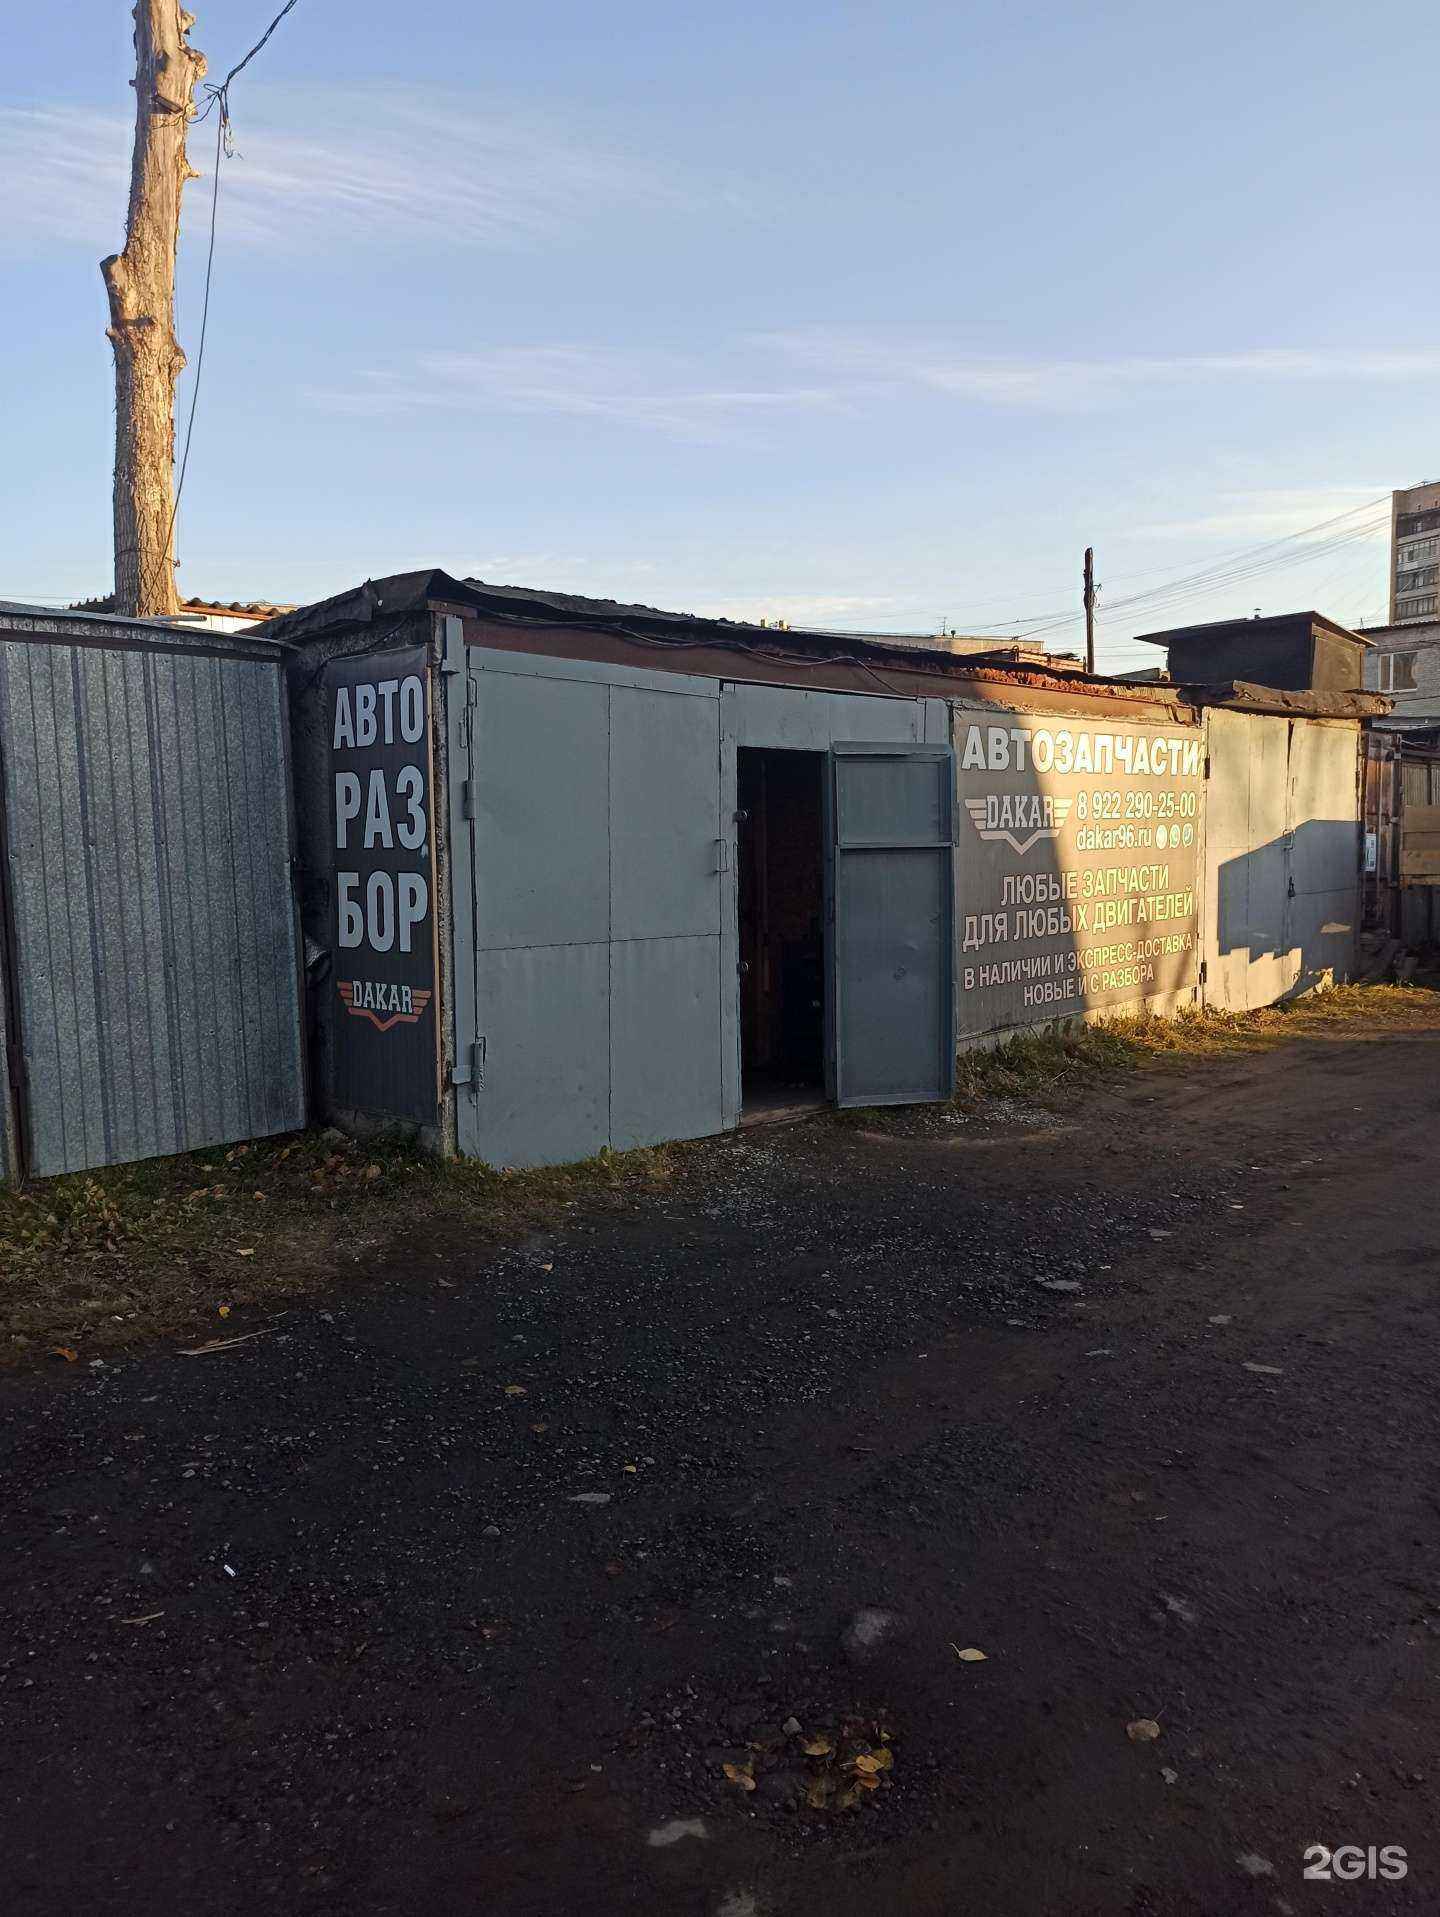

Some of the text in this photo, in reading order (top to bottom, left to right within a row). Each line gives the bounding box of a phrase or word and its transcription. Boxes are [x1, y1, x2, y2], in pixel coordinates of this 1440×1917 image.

[333, 675, 424, 749] АВТО
[961, 725, 1199, 776] АВТОЗАПЧАСТИ
[335, 765, 427, 849] РАЗ
[986, 794, 1056, 829] DAKAR
[1077, 790, 1197, 820] 8 922 290-25-00
[1076, 823, 1152, 851] dakar96.ru
[1000, 864, 1169, 906] ЛЮБЫЕ ЗАПЧАСТИ
[337, 870, 428, 953] БОР
[962, 885, 1194, 953] ДЛЯ ЛЮБЫХ ДВИГАТЕЛЕЙ
[963, 933, 1193, 990] В НАЛИЧИИ И ЭКСПРЕСС-ДОСТАВКА
[1024, 963, 1154, 1006] НОВЫЕ И С РАЗБОРА
[351, 980, 413, 1014] DAKAR
